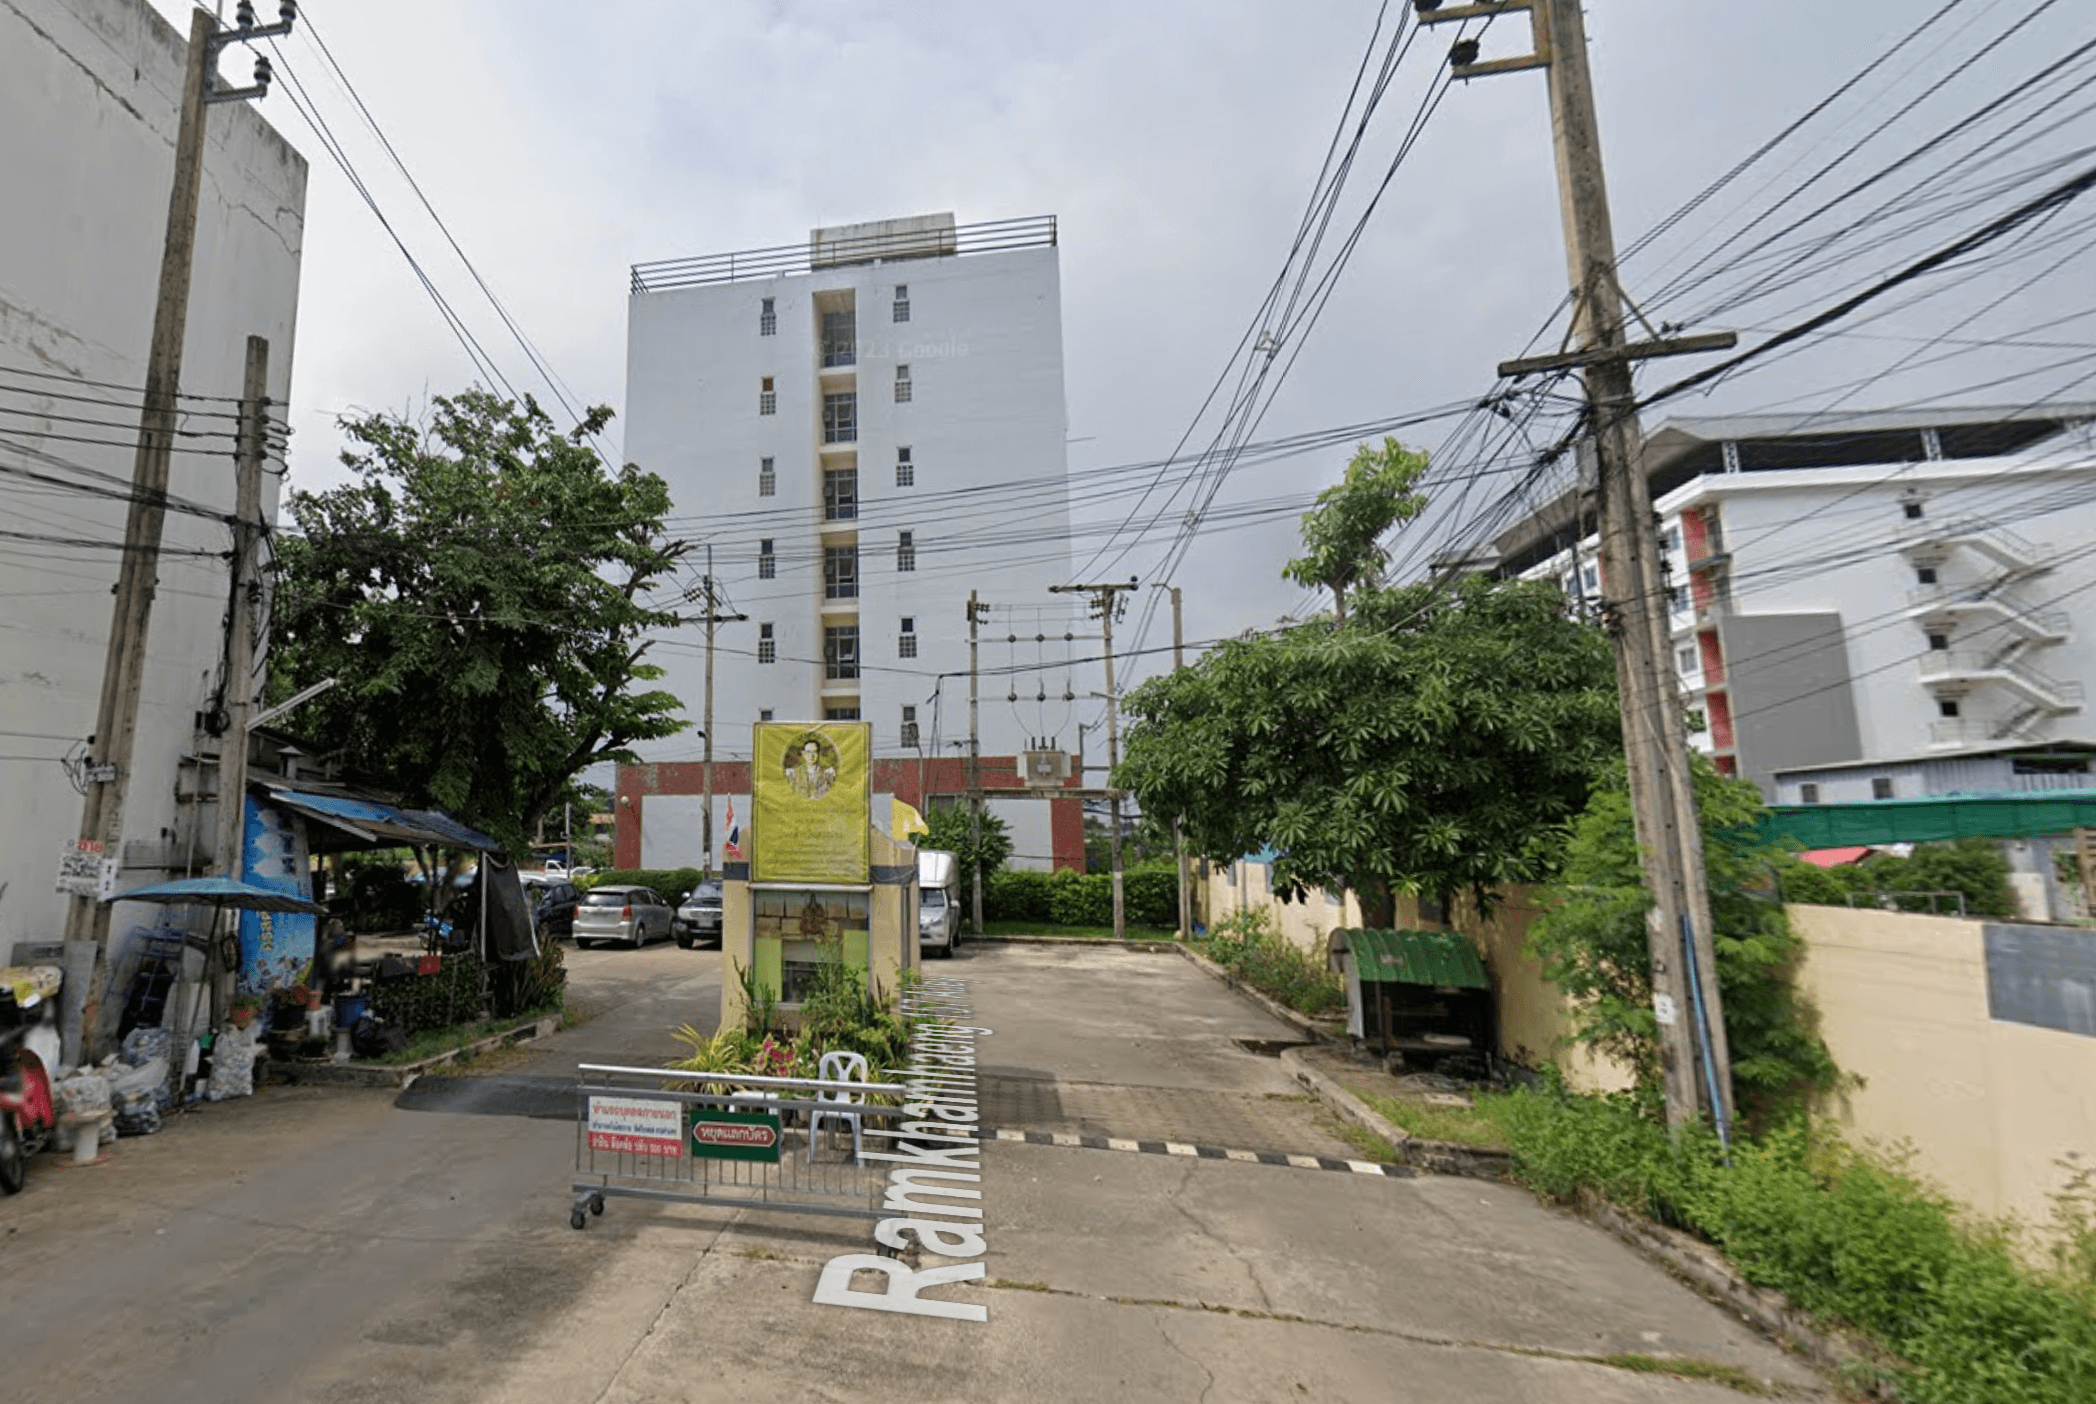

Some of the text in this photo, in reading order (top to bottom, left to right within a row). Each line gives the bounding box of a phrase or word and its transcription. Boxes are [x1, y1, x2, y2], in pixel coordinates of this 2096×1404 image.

[700, 1125, 768, 1142] หยุดแลกบัตร
